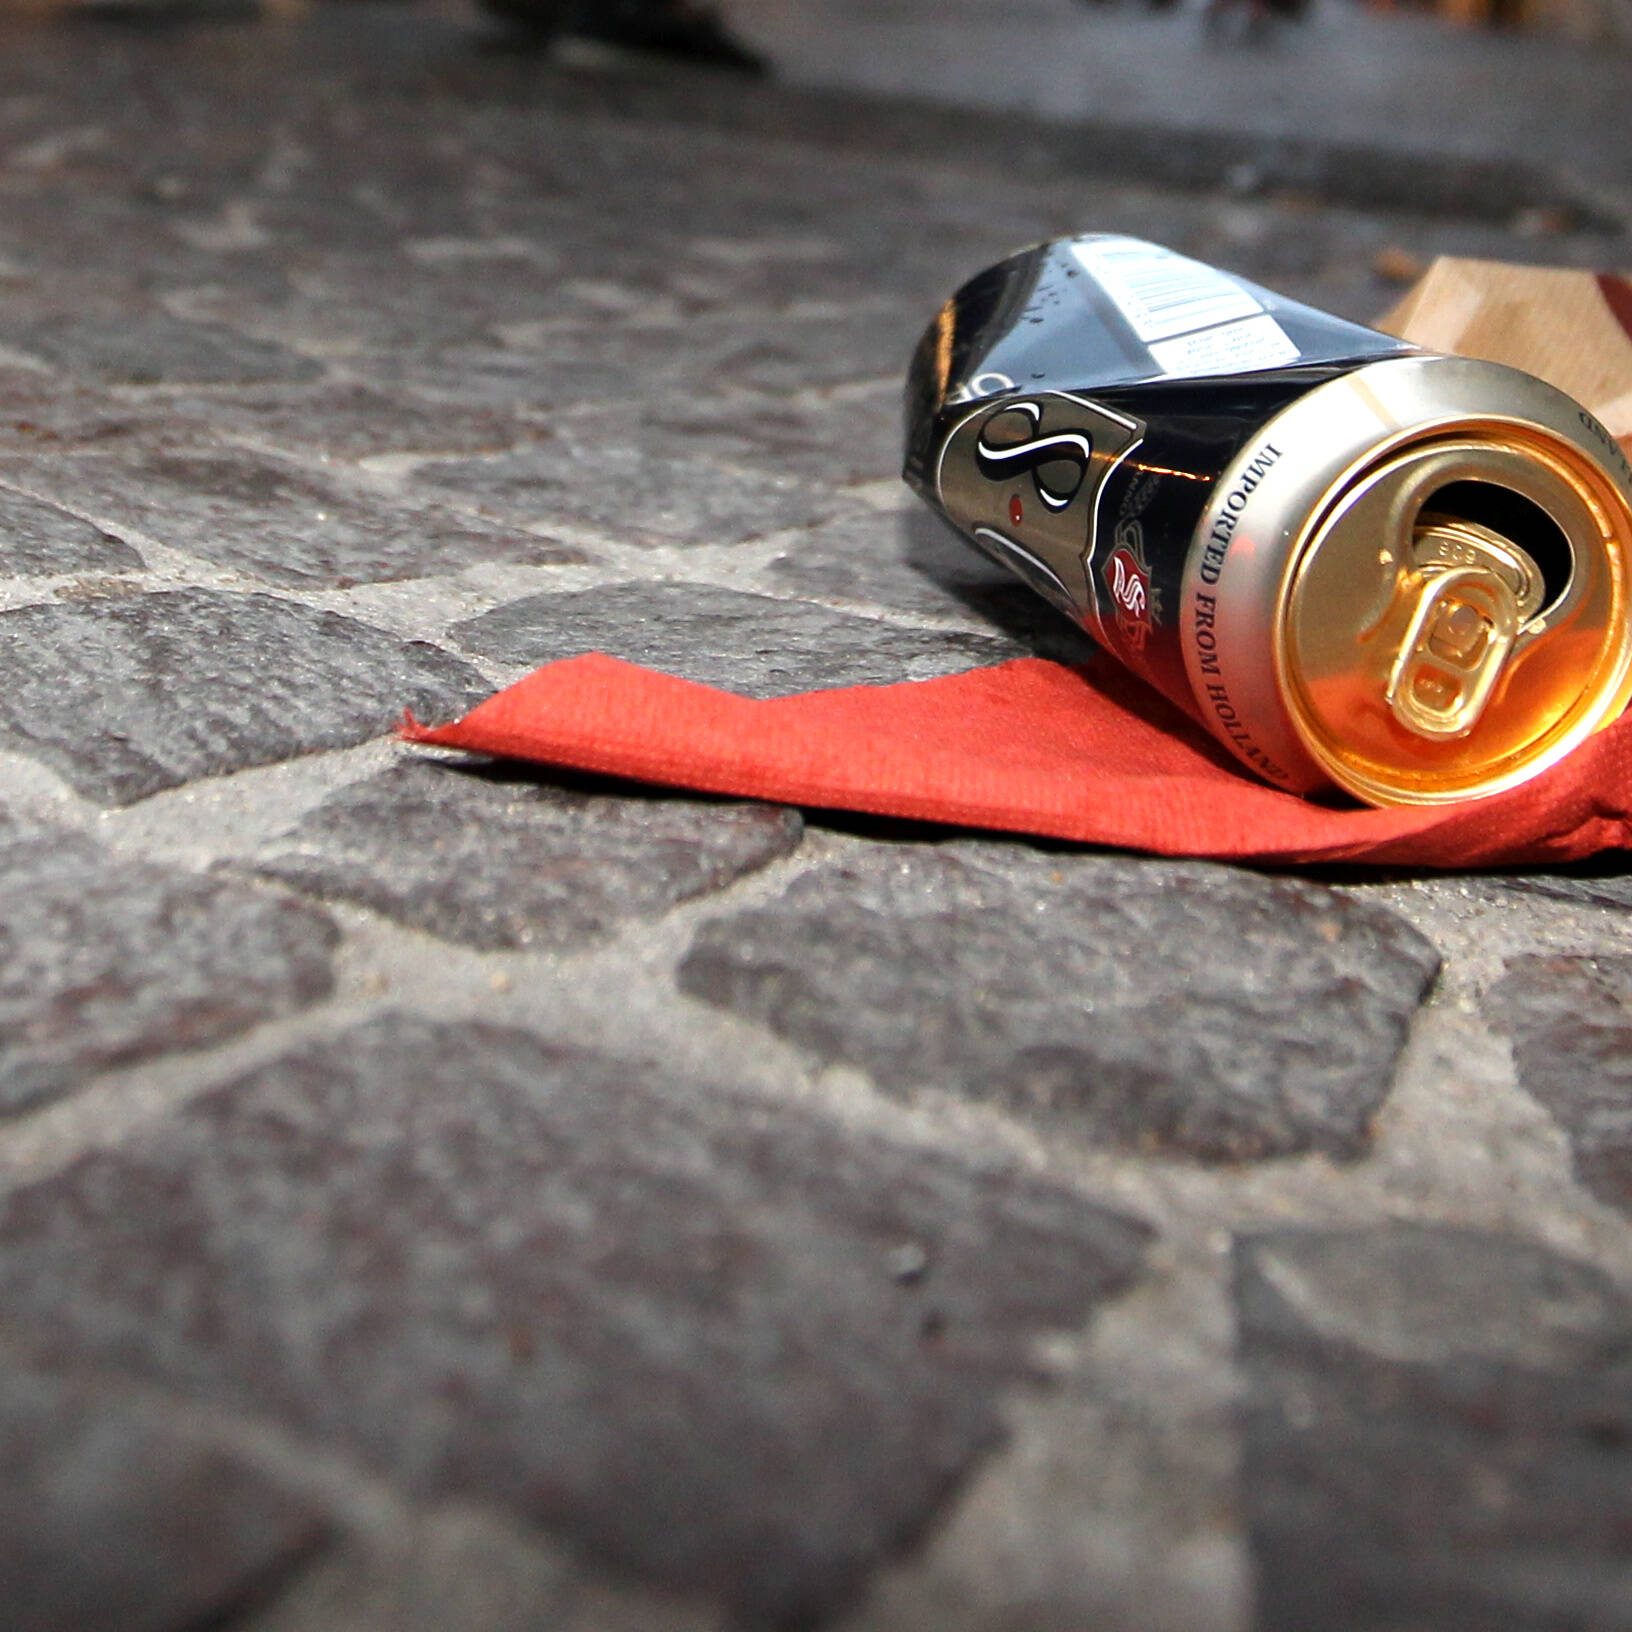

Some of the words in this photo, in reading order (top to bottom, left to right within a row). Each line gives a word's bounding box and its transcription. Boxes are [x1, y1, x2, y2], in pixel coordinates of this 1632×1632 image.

[1200, 444, 1283, 585] IMPORTED
[1195, 592, 1220, 676] FROM
[1206, 683, 1290, 780] HOLLAND
